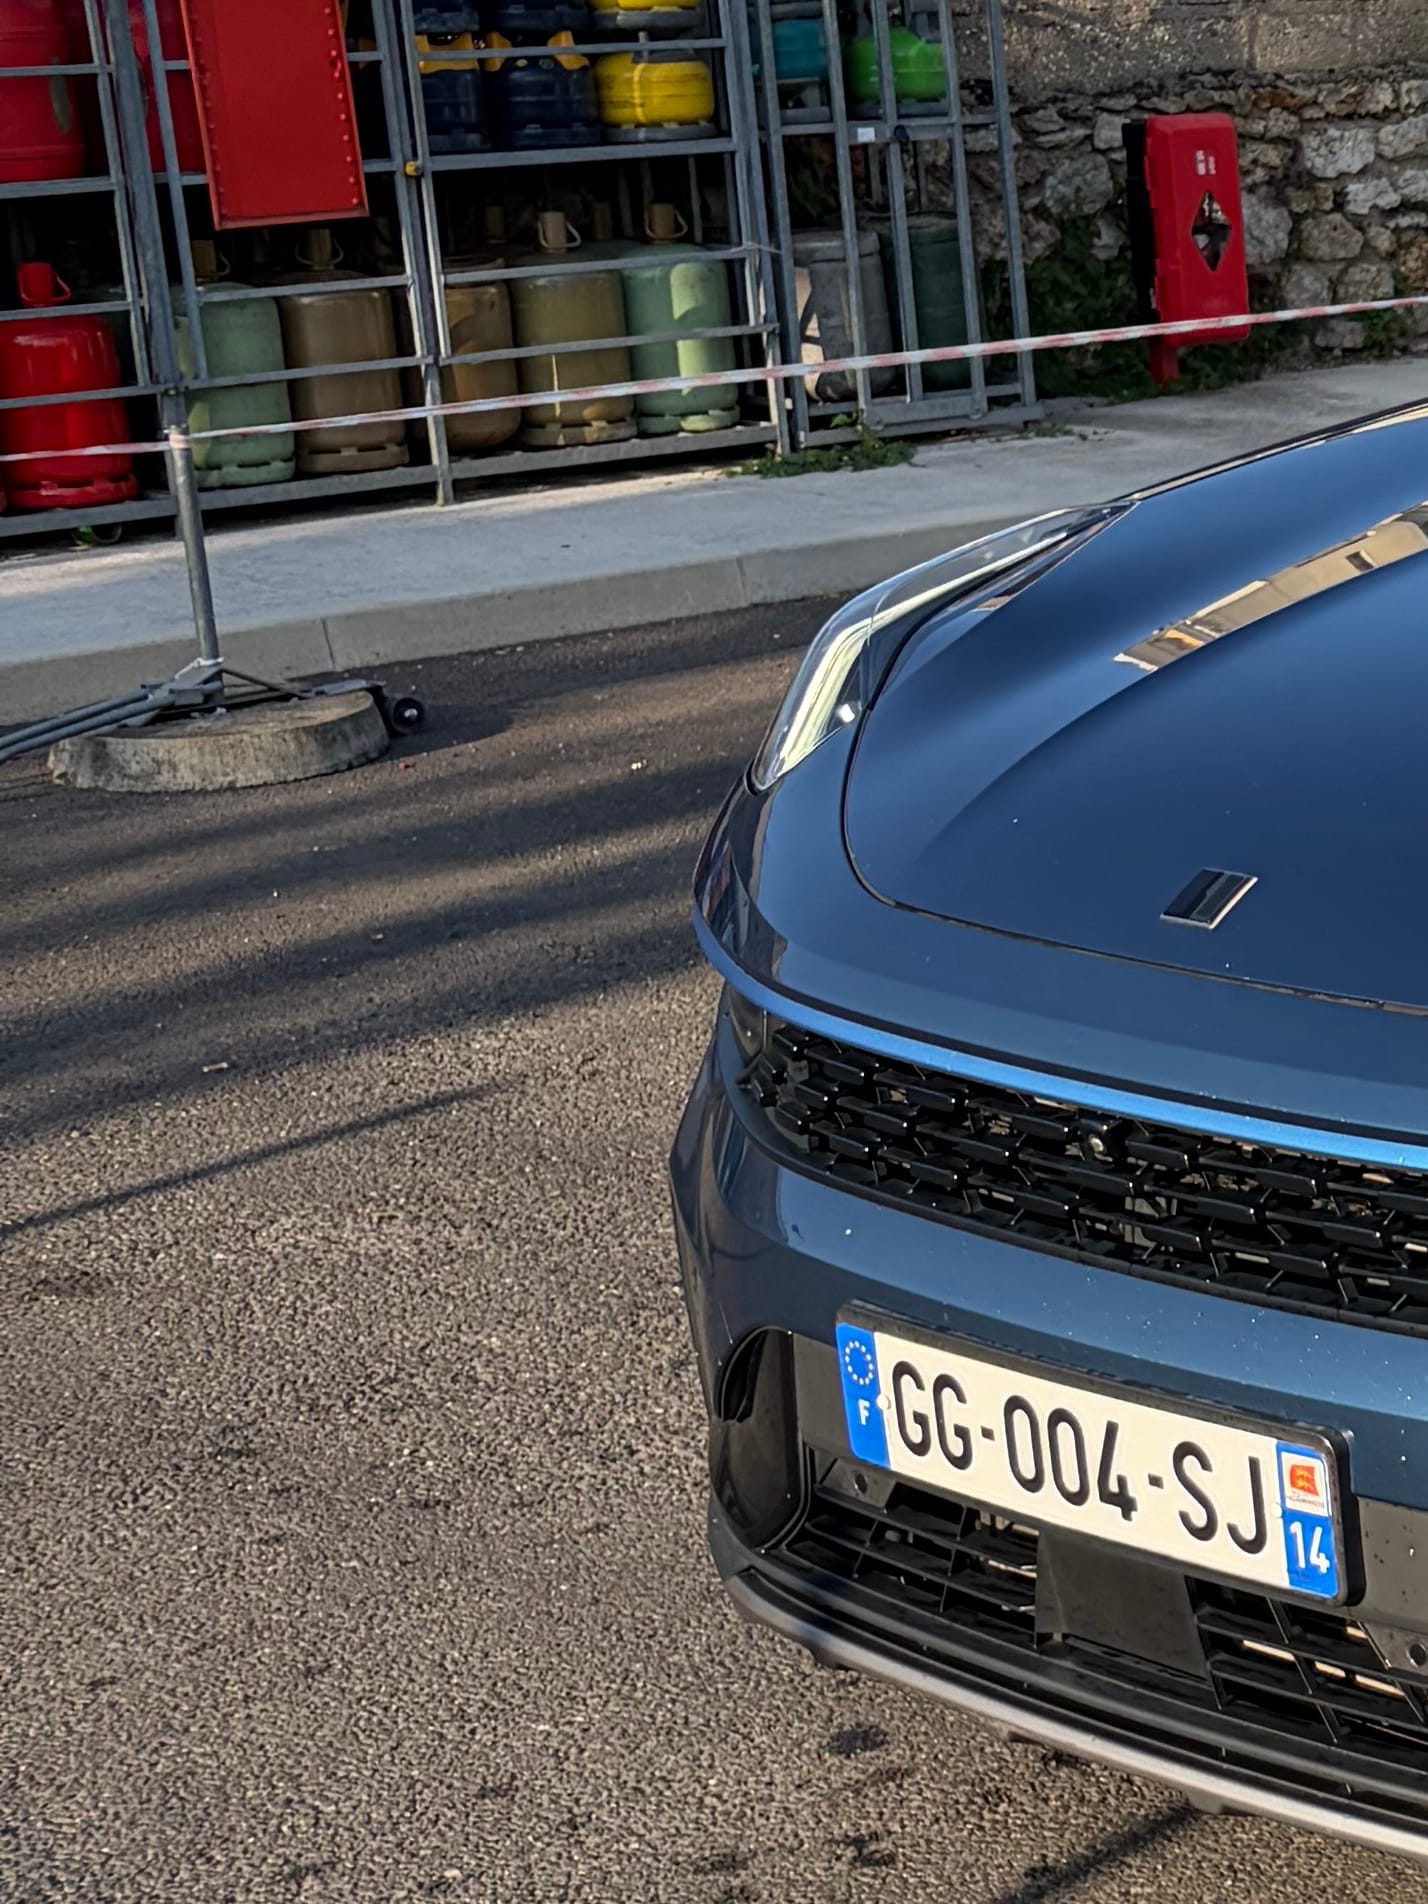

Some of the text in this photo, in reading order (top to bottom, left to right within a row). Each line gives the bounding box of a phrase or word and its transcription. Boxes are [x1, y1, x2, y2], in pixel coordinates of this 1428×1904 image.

[858, 1399, 871, 1426] F
[892, 1360, 1268, 1556] GG-004-SJ
[1289, 1521, 1331, 1575] 14
